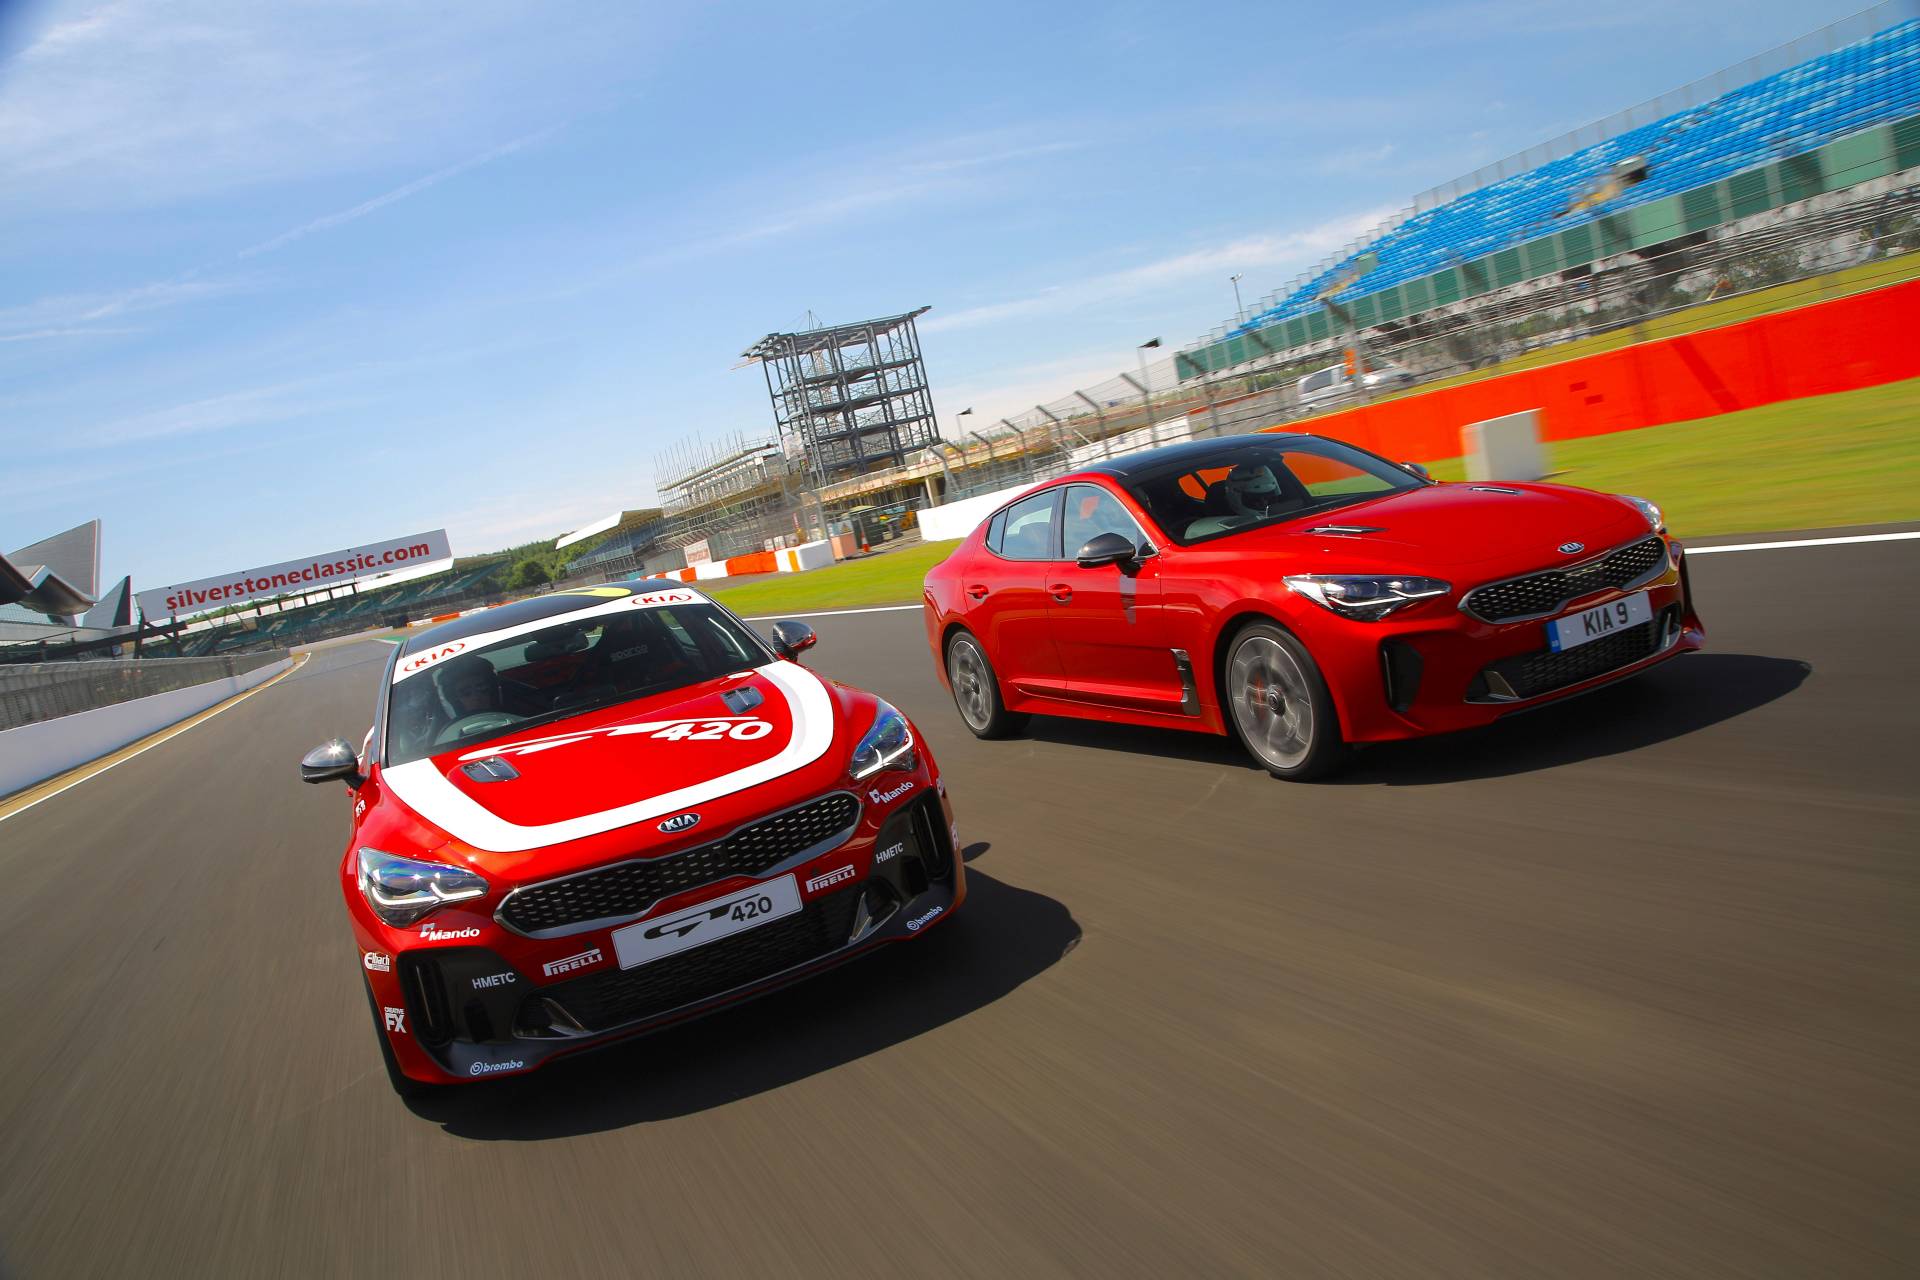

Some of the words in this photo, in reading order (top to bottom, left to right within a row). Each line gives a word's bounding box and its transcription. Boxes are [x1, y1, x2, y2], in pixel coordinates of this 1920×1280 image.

[1562, 542, 1583, 553] KIA
[166, 543, 430, 610] silverstoneclassic.com
[640, 594, 687, 605] KIA
[1582, 607, 1614, 636] KIA
[1616, 602, 1628, 624] 9
[412, 647, 459, 669] KIA
[650, 721, 774, 741] 420
[880, 781, 914, 803] Mando
[664, 814, 697, 831] KIA
[876, 842, 904, 864] HMETC
[806, 864, 856, 893] PIRELLI
[731, 896, 772, 922] 420
[916, 905, 943, 925] brembo
[429, 927, 480, 941] Mando
[543, 948, 603, 976] PIRELLI
[472, 972, 516, 989] HMETC
[385, 1012, 407, 1034] FX
[482, 1060, 524, 1073] brembo
